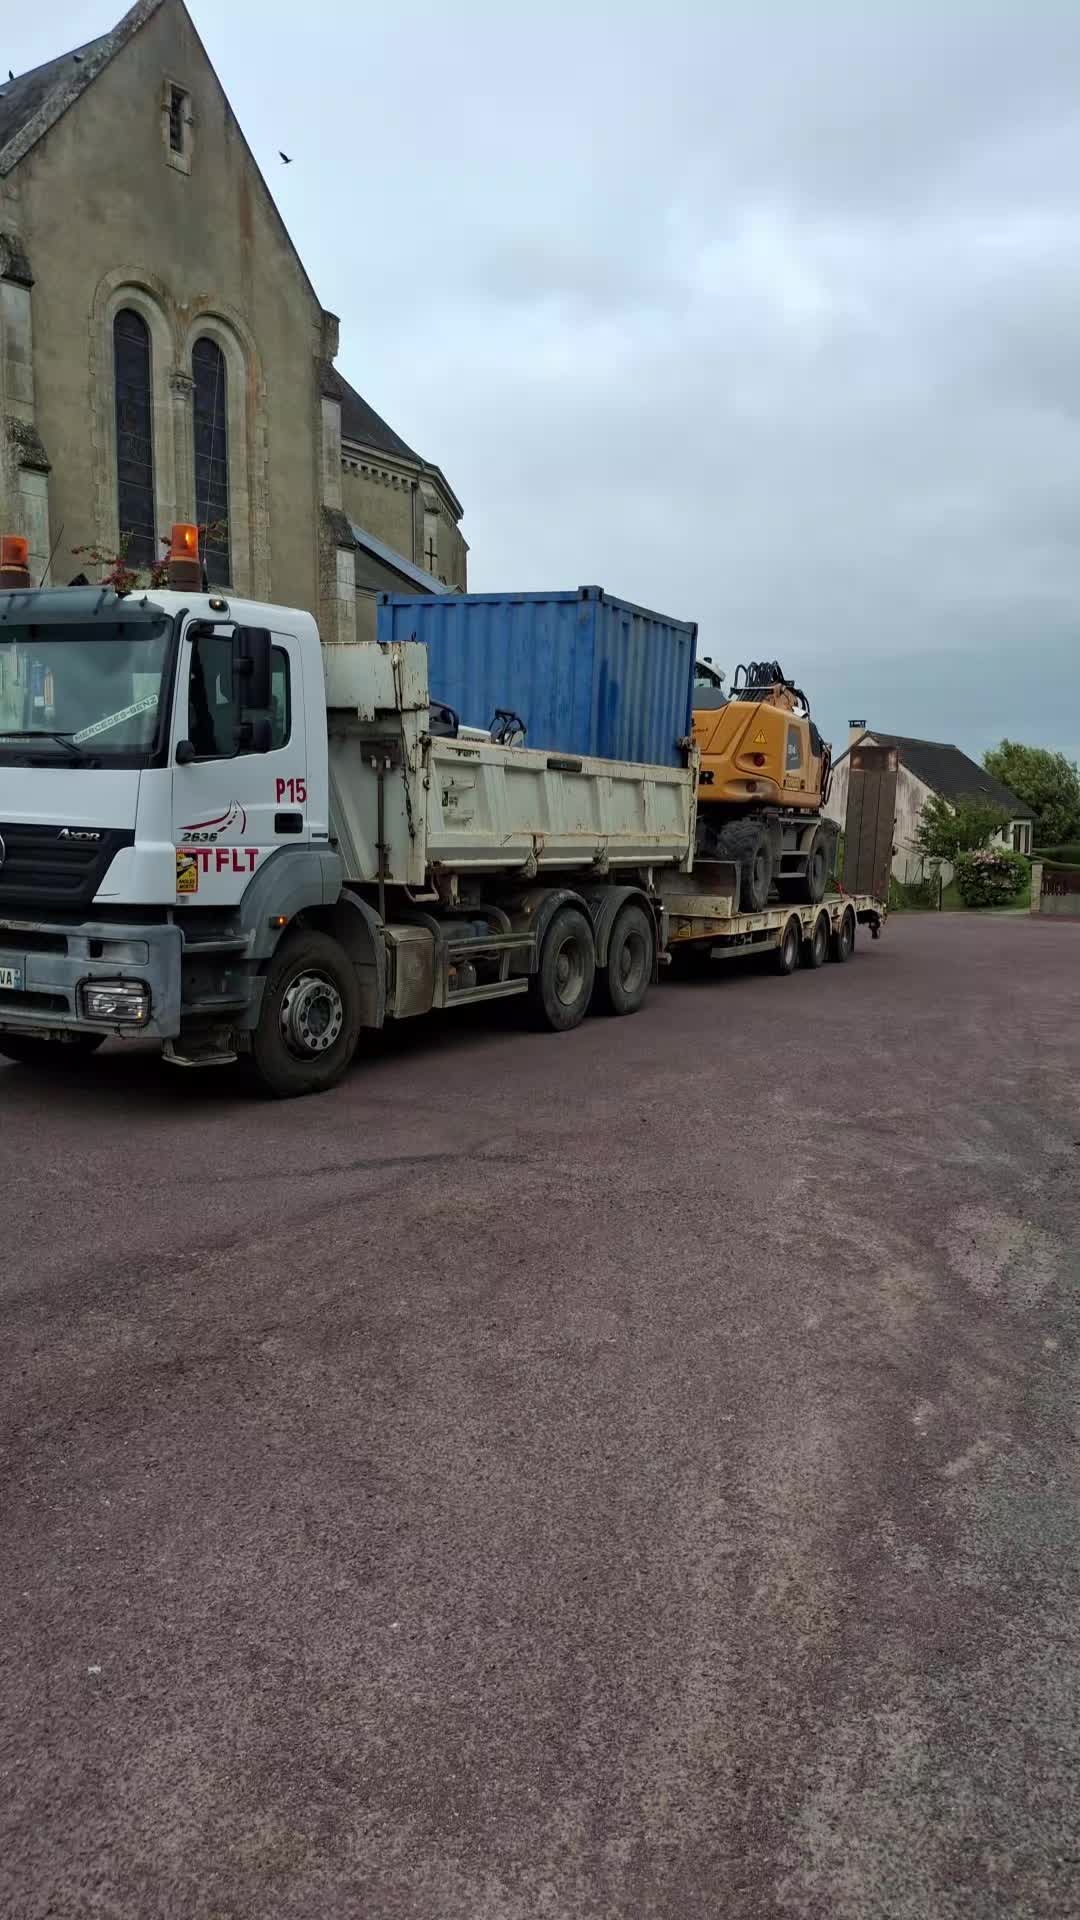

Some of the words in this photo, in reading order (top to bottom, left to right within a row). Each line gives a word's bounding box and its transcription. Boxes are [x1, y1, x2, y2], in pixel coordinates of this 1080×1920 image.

[275, 778, 307, 804] P15
[181, 832, 218, 842] 2636
[196, 848, 259, 873] TFLT
